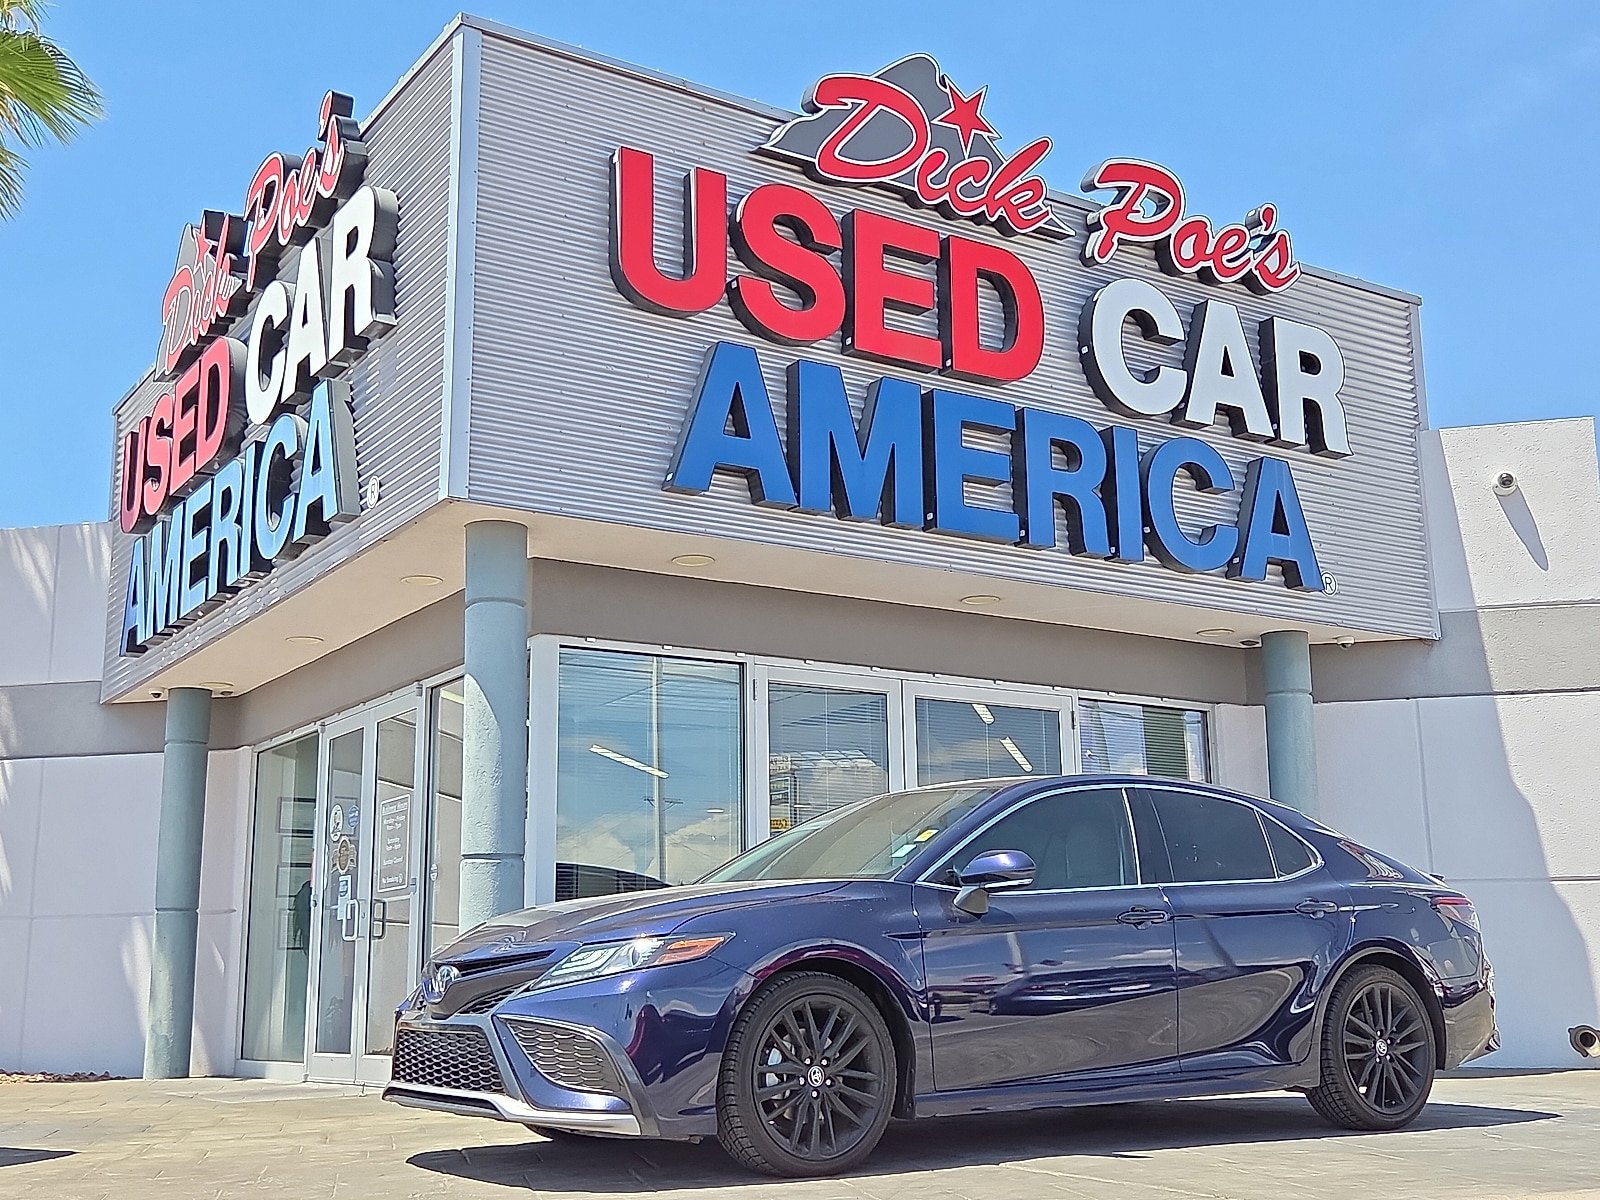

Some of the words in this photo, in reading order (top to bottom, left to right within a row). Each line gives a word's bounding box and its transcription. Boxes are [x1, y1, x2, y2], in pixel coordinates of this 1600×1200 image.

[161, 216, 237, 376] Dick
[244, 91, 344, 291] Poe's
[613, 147, 1045, 382] USED
[1088, 279, 1352, 456] CAR
[816, 74, 1052, 234] Dick
[1084, 159, 1301, 292] Poe's
[121, 336, 231, 532] USED
[245, 187, 376, 425] CAR
[670, 342, 1322, 592] AMERICA
[121, 379, 338, 656] AMERICA
